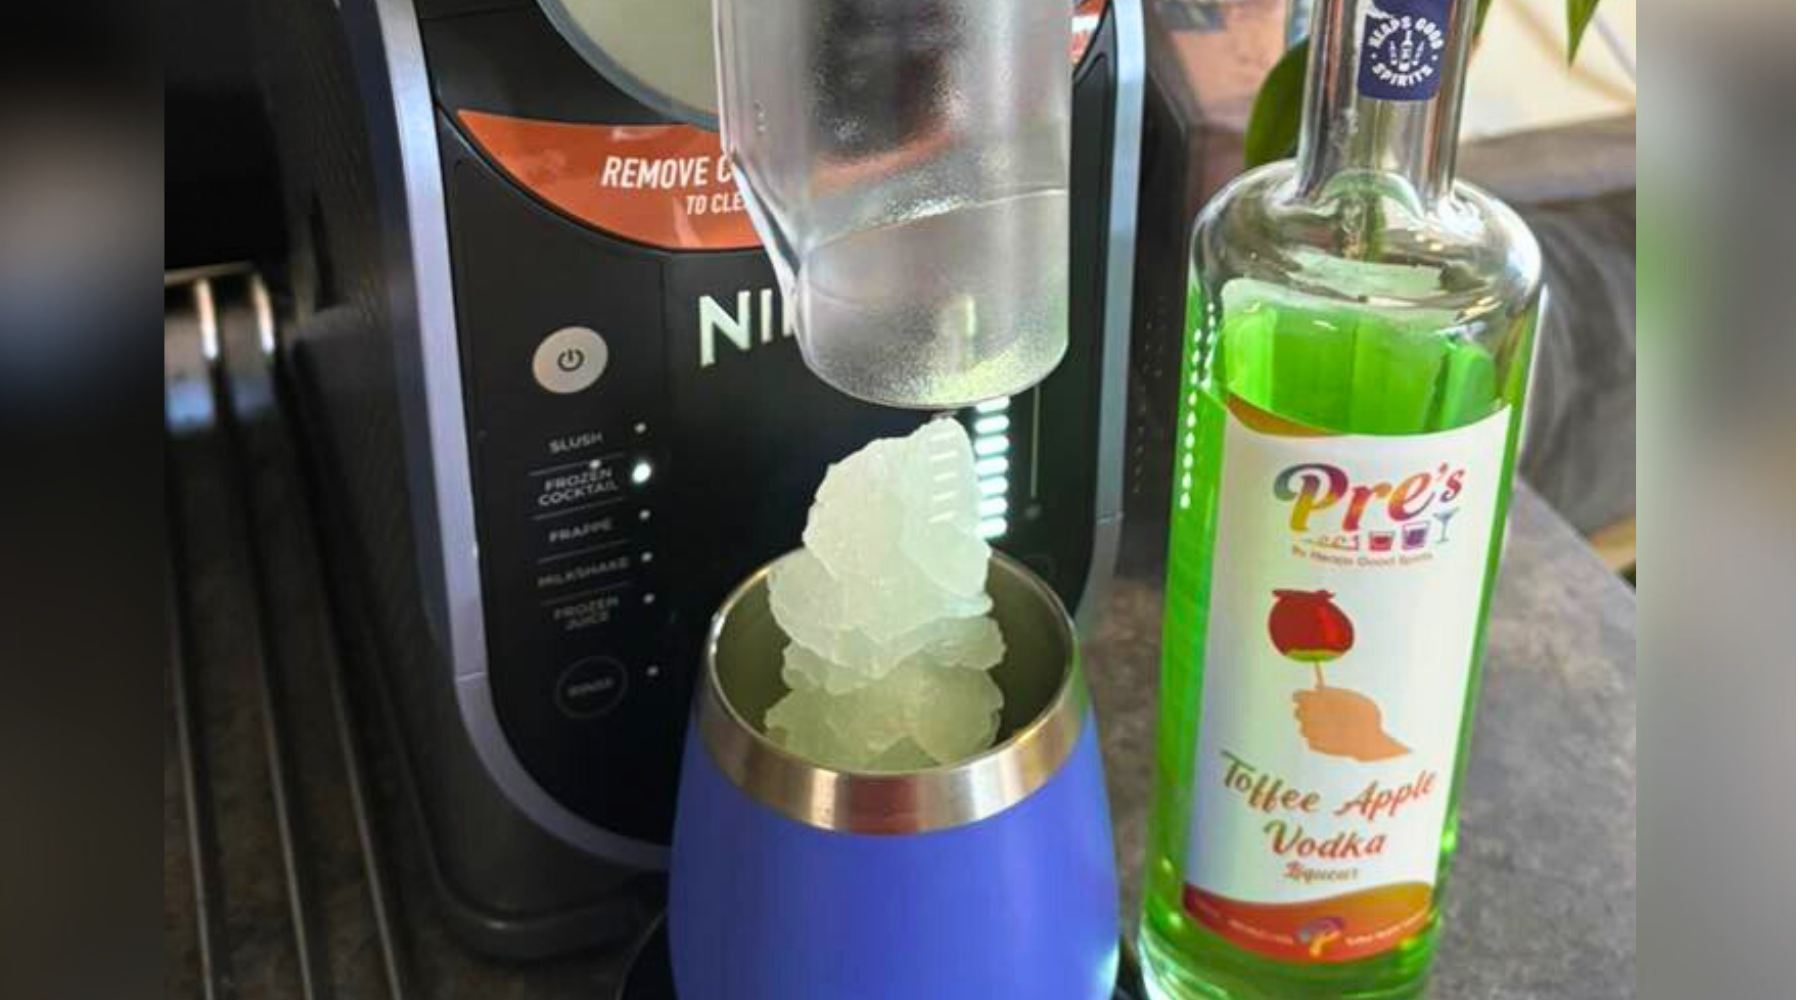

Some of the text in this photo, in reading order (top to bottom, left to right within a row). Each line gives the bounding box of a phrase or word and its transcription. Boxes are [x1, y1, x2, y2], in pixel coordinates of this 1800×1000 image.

[1368, 15, 1444, 49] HEAPS GOOD
[1372, 63, 1434, 87] SPIRITS
[601, 156, 710, 190] REMOVE
[686, 194, 747, 215] TO CLE
[549, 432, 604, 454] SLUSH
[538, 481, 618, 506] COCKTAIL
[544, 468, 613, 491] FROZEN
[1273, 462, 1465, 532] Pre's
[1220, 750, 1436, 820] Toffee Apple
[1264, 819, 1387, 859] Vodka
